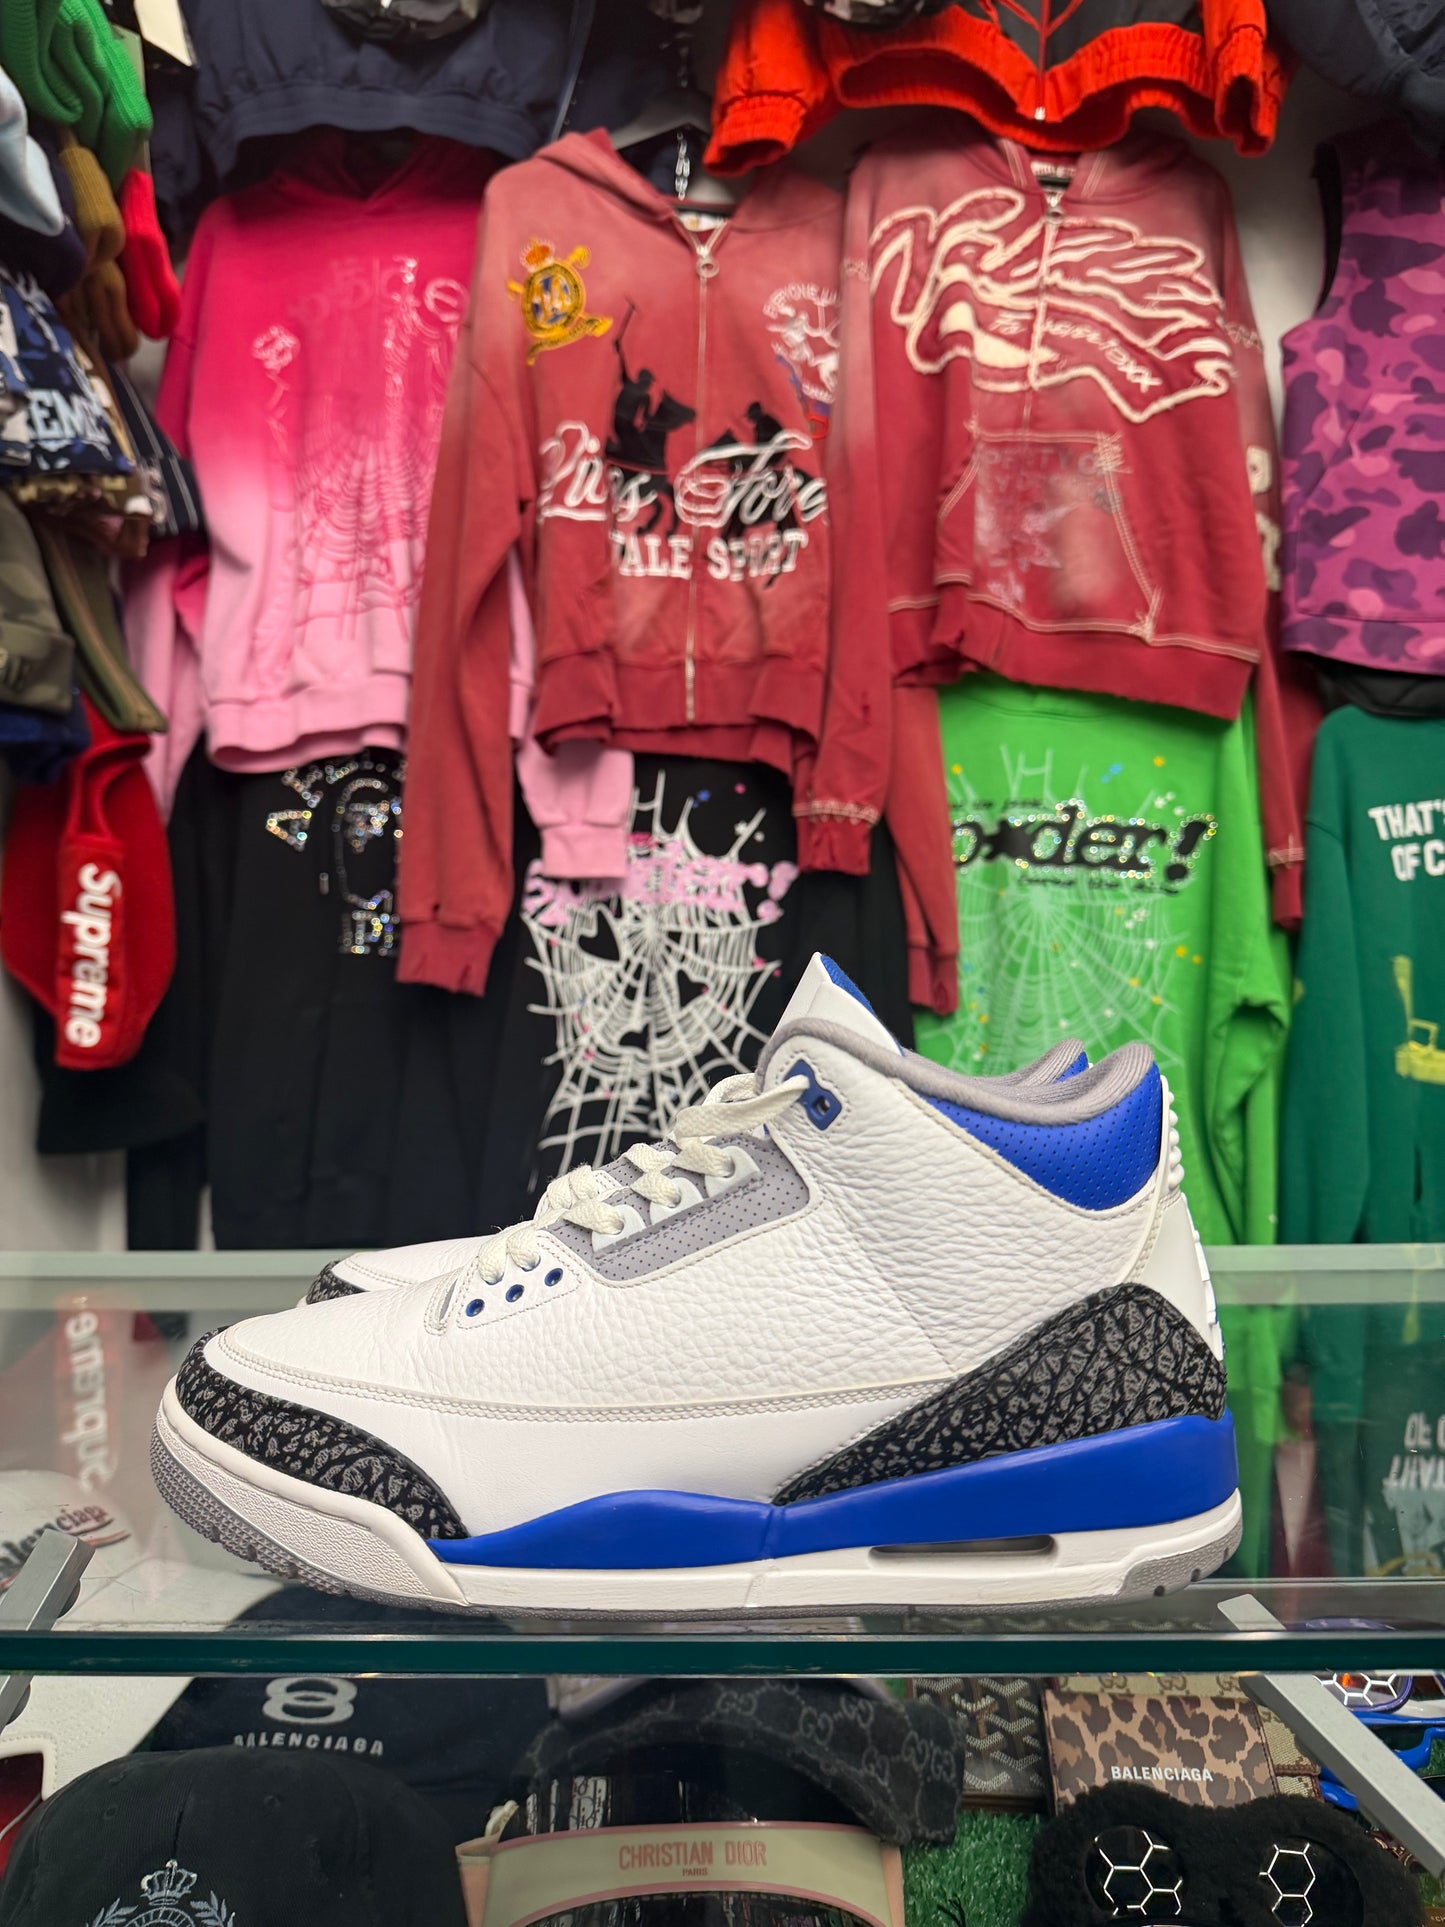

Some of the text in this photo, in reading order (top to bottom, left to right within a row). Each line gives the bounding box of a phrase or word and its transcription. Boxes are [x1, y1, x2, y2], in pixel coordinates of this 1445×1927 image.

[1367, 799, 1445, 841] THAT'
[1390, 842, 1421, 882] OF
[60, 862, 123, 1048] Supreme
[1110, 1764, 1214, 1783] BALENCIAGA
[618, 1840, 768, 1870] CHRISTIAN DIOR
[682, 1867, 708, 1876] PARIS
